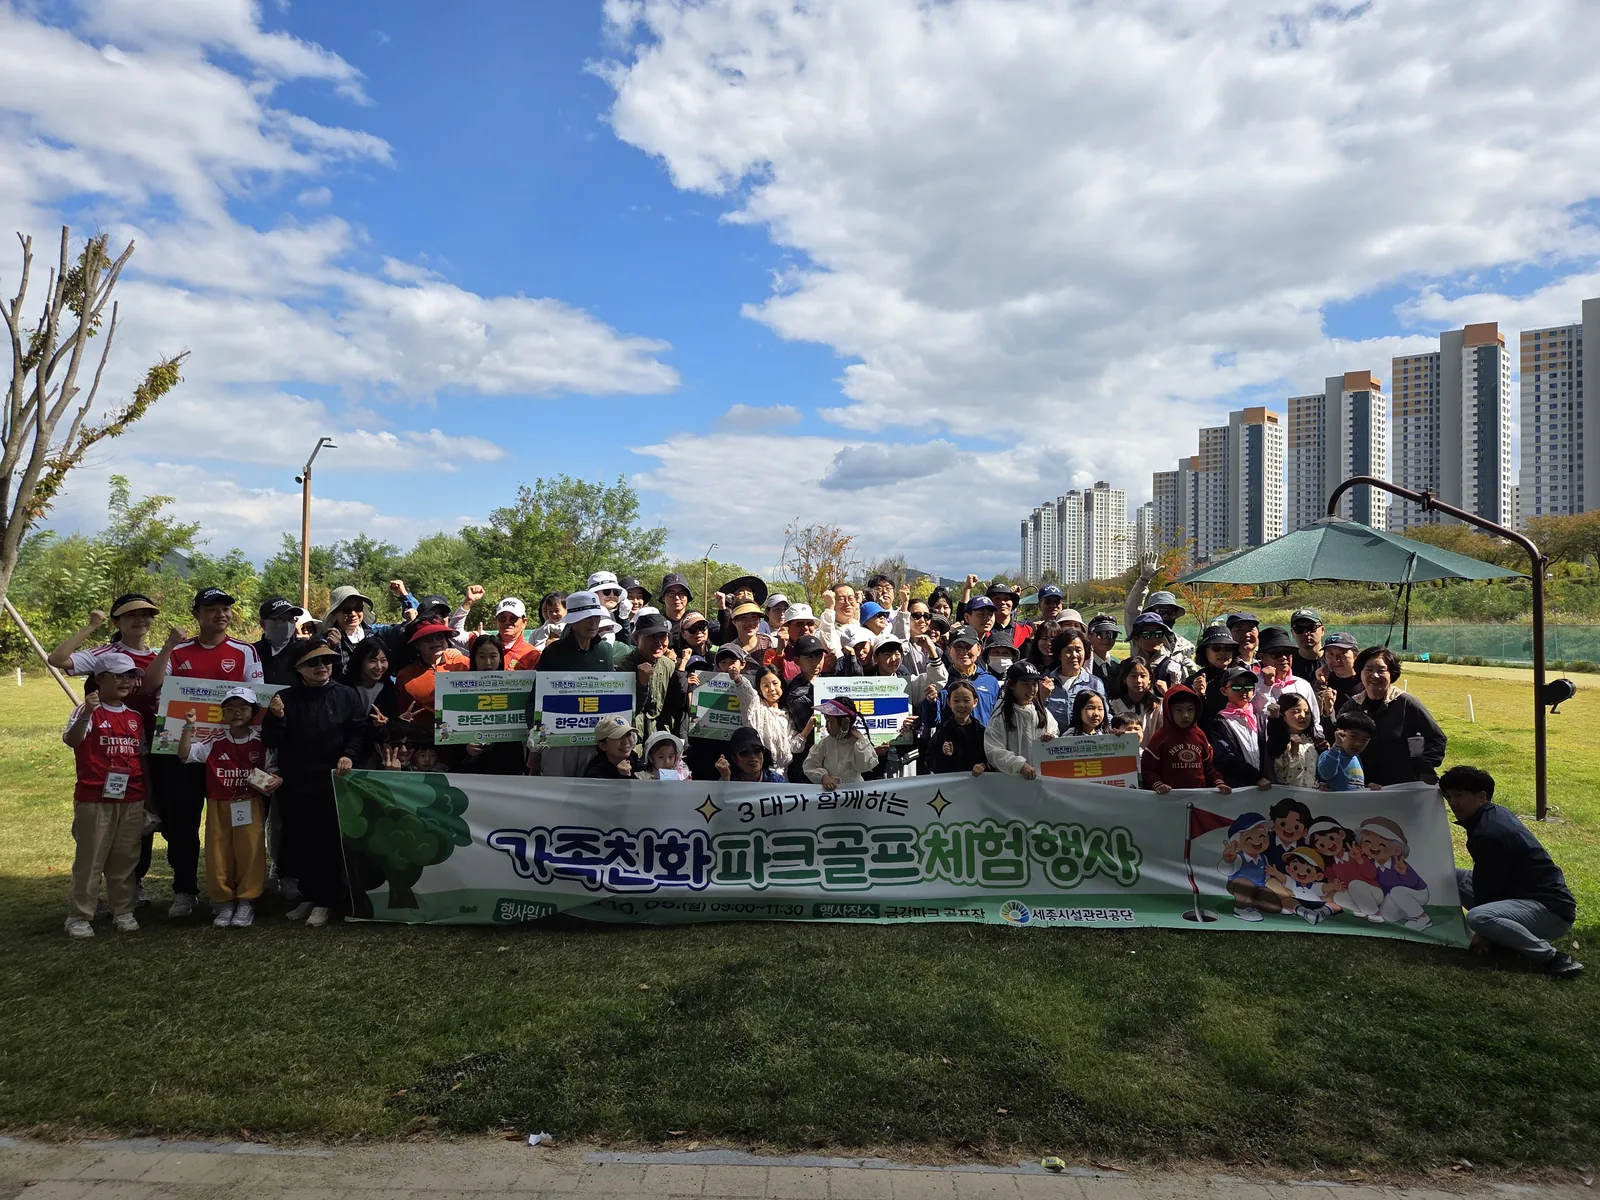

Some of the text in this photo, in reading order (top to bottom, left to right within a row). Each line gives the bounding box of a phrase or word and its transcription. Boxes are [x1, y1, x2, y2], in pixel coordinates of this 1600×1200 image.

[477, 694, 508, 710] 2등
[577, 697, 599, 713] 1등
[727, 696, 740, 712] 2
[854, 700, 875, 715] 1등
[207, 706, 224, 723] 3
[457, 713, 527, 726] 한돈선물세트
[708, 712, 742, 725] 한돈선
[555, 716, 604, 729] 한우선물
[854, 718, 898, 730] 선물세트
[99, 735, 140, 746] Emrates
[1168, 743, 1184, 756] NEW
[1073, 760, 1103, 777] 3등
[816, 790, 909, 817] 함께하는
[819, 904, 876, 918] 행사장소
[884, 906, 941, 919] 금강파크
[1031, 908, 1133, 922] 세종시설관리공단
